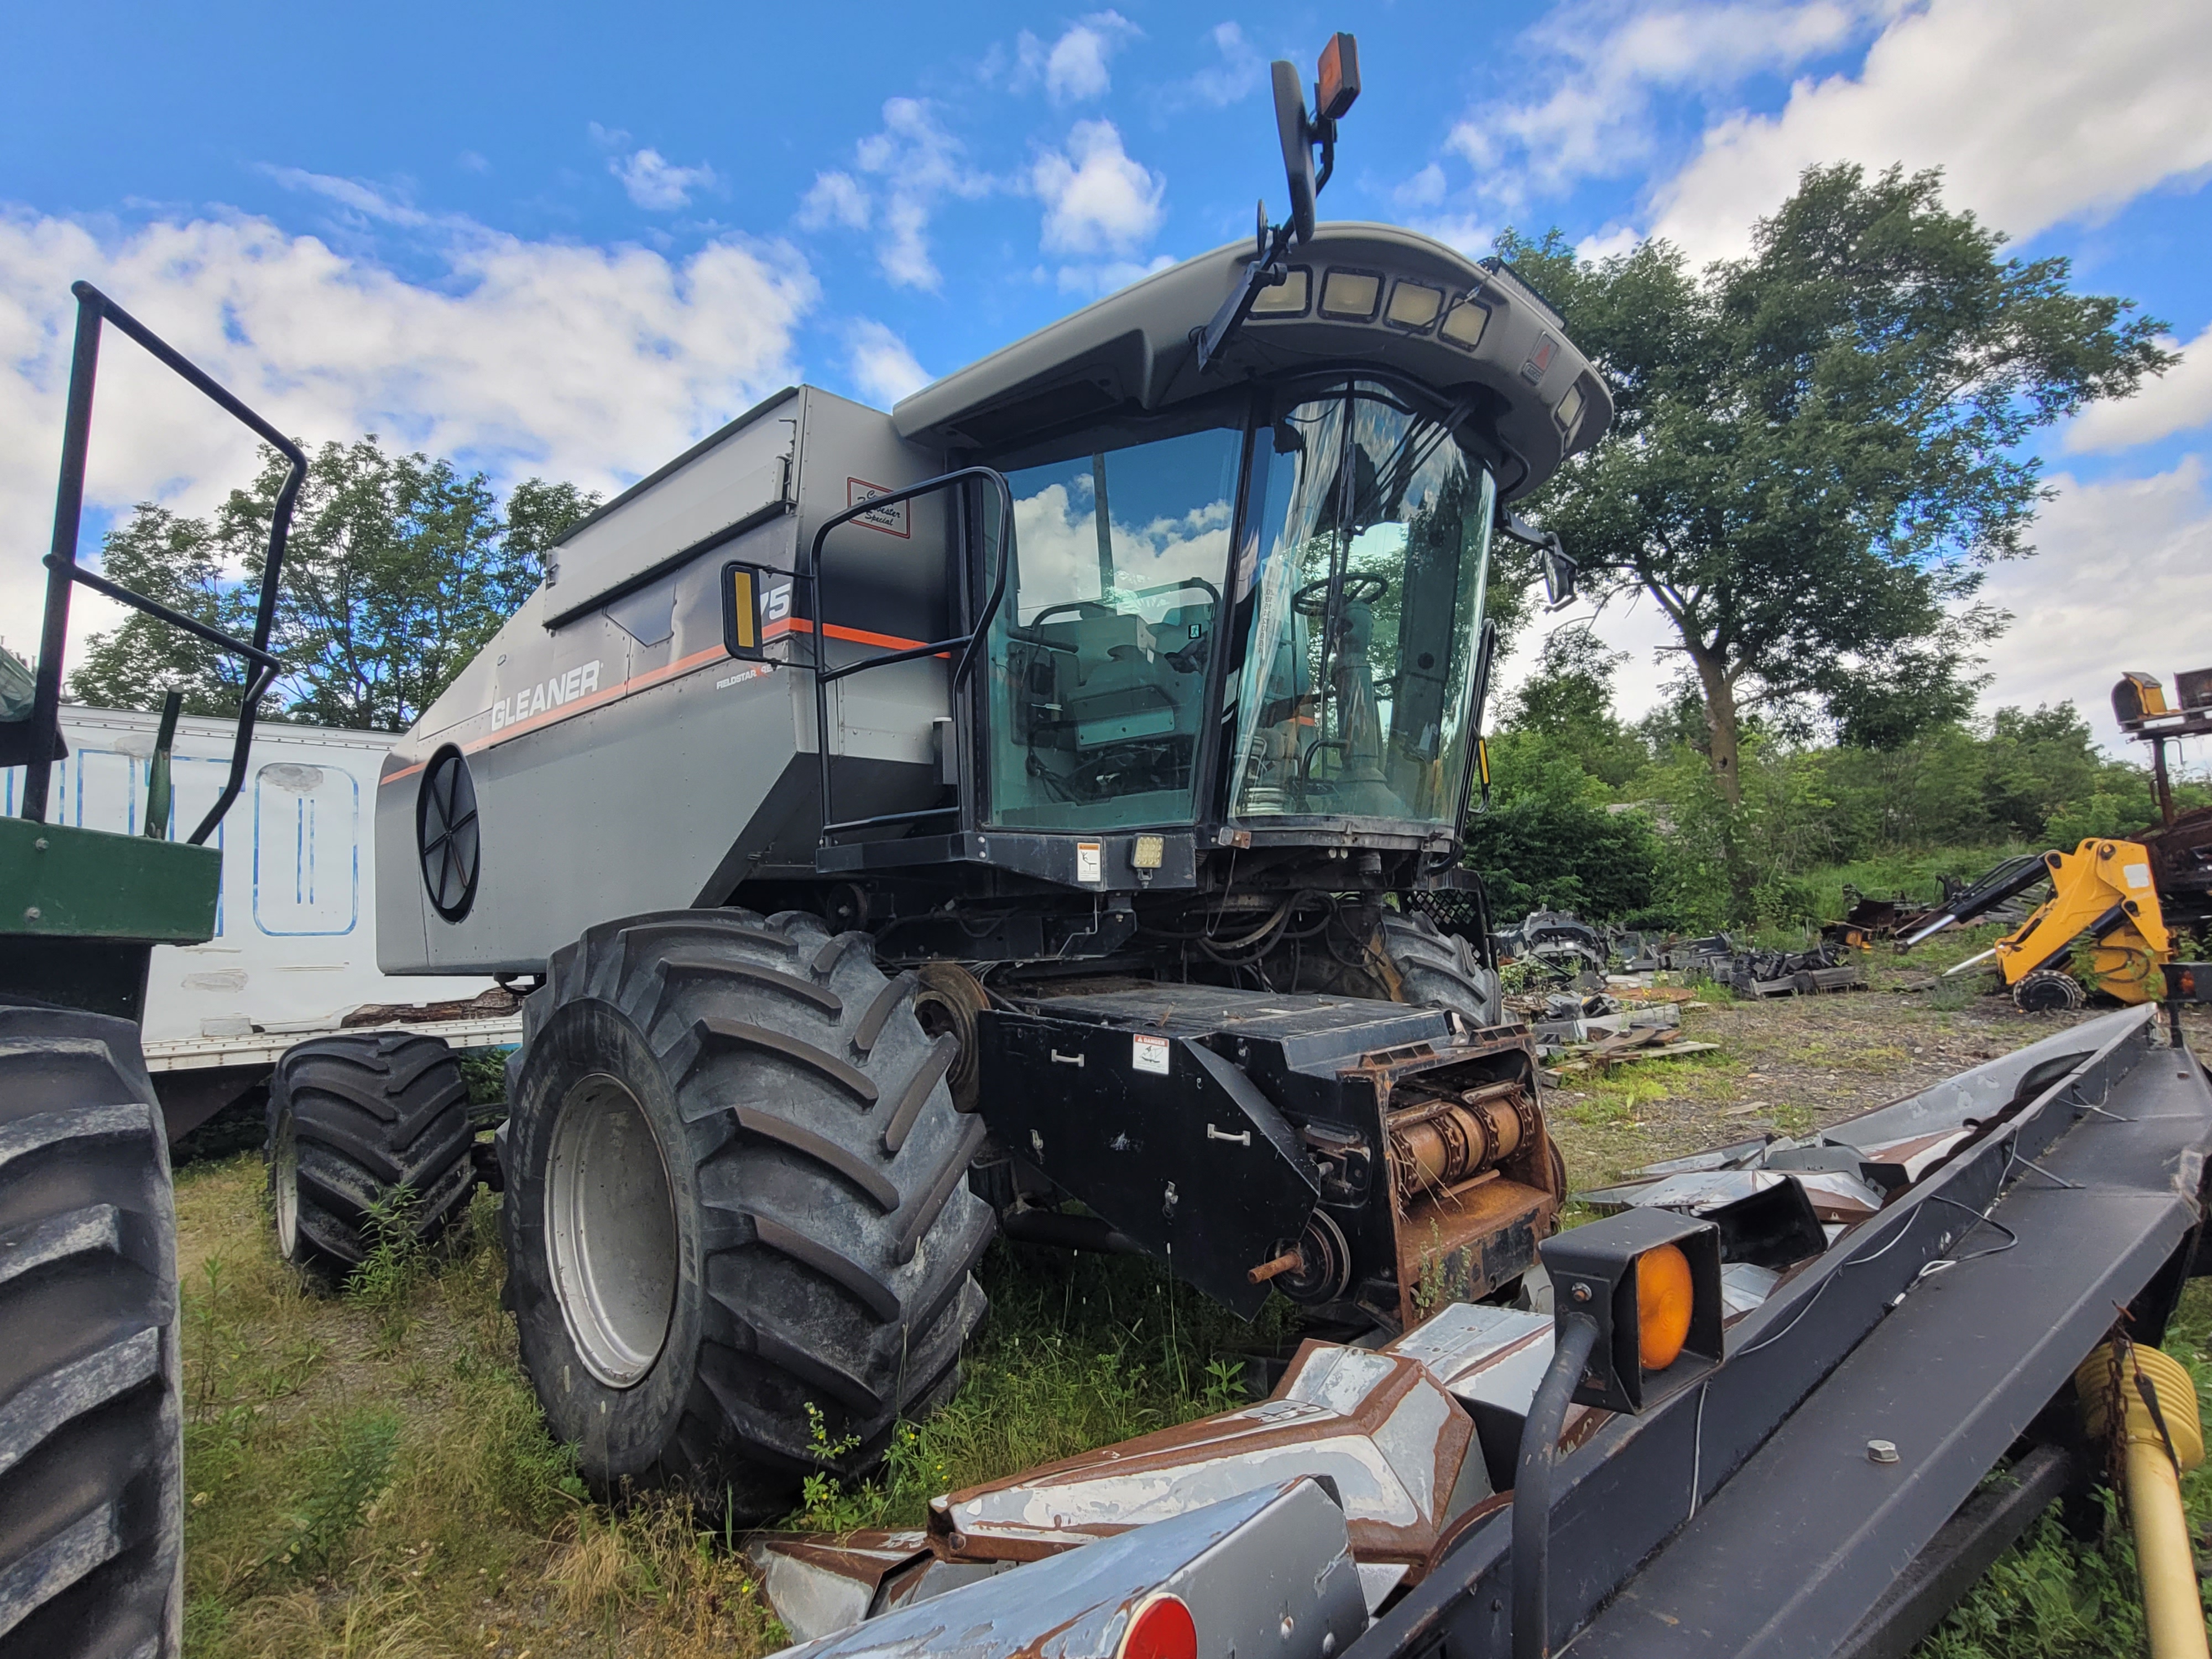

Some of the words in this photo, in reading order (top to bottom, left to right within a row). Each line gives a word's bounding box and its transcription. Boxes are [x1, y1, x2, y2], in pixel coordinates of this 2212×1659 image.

[865, 510, 893, 526] Special
[716, 670, 757, 690] FIELDSTAR
[492, 660, 600, 732] GLEANER
[1143, 1037, 1165, 1046] DANGER
